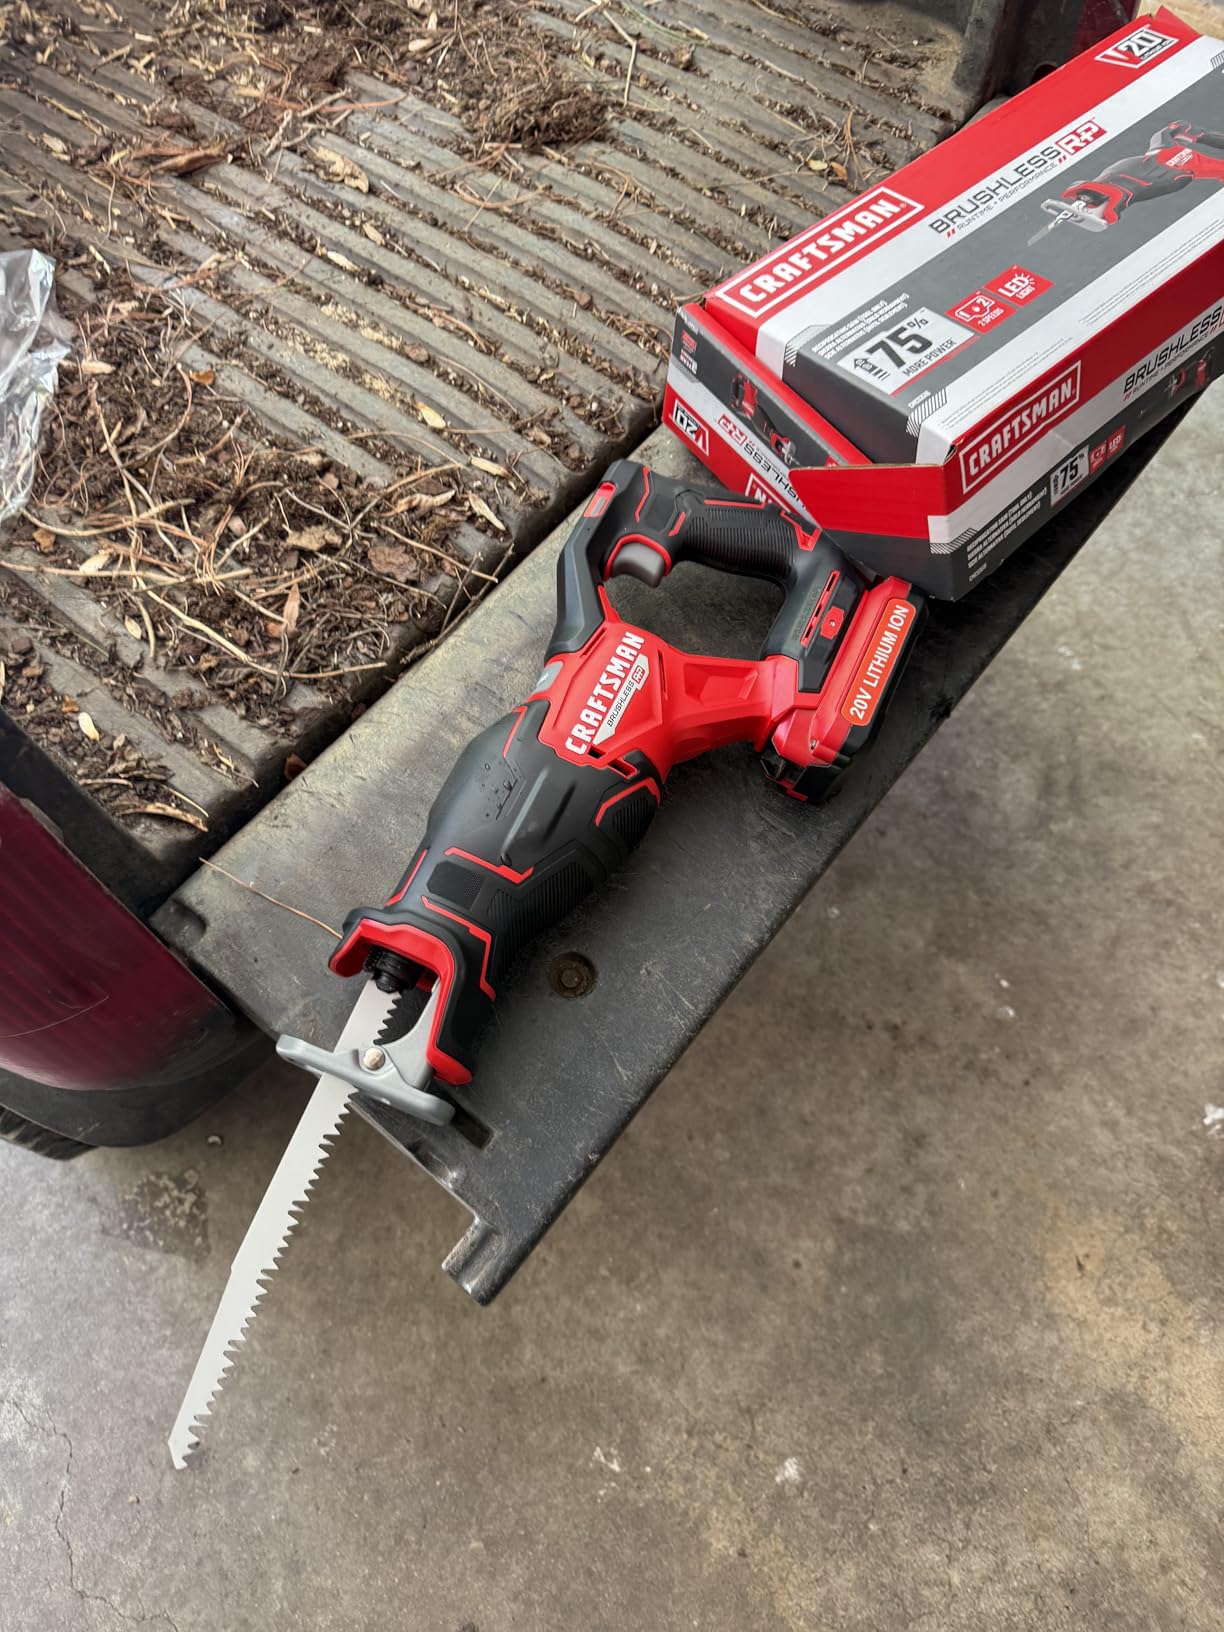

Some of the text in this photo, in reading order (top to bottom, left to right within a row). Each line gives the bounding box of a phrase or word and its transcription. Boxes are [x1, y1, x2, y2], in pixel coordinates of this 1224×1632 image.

[928, 146, 1061, 234] BRUSHLESS
[957, 162, 1058, 230] RUNTIME PERFORMANCE
[739, 199, 902, 302] CRAFTSMAN
[997, 276, 1030, 298] LED
[902, 358, 927, 377] MORE
[925, 338, 956, 365] POWER
[1123, 305, 1222, 394] BRUSHLESS
[968, 377, 1073, 477] CRAFTSMAN
[744, 443, 801, 502] SHLESS
[565, 631, 645, 755] CRAFTSMAN
[606, 679, 635, 728] BRUSHLESS
[848, 604, 911, 720] 20V LITHIUM ION
